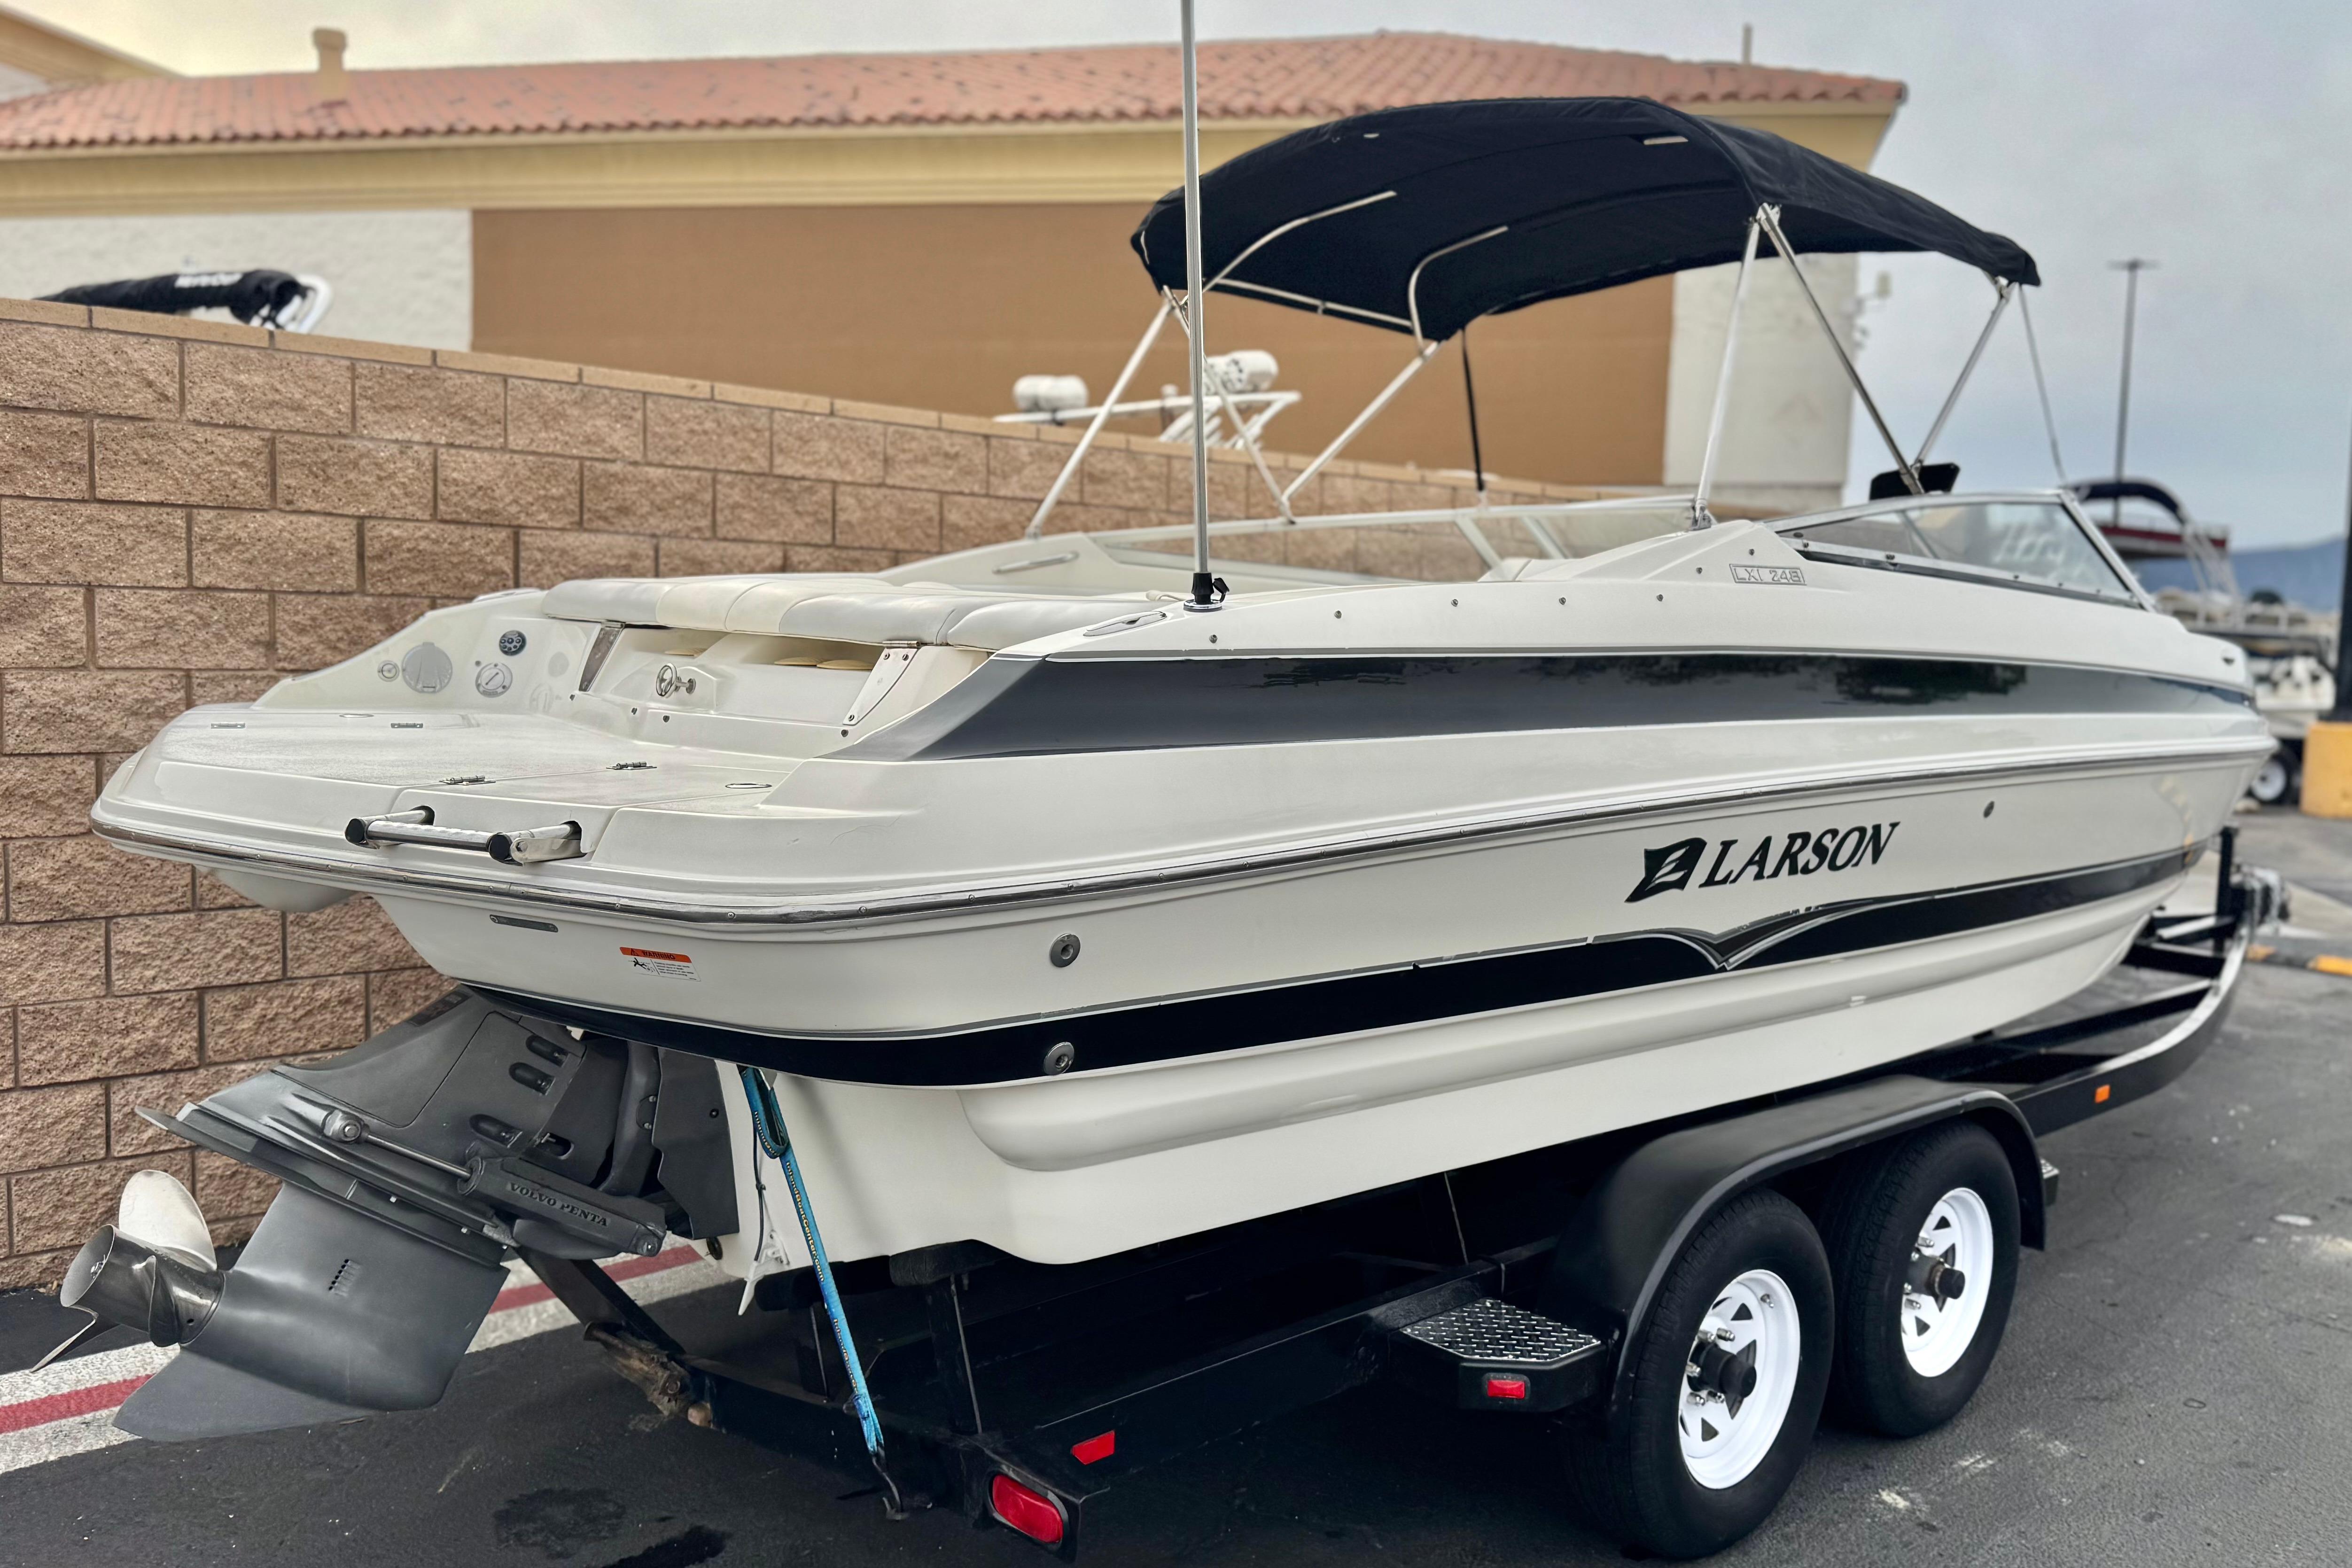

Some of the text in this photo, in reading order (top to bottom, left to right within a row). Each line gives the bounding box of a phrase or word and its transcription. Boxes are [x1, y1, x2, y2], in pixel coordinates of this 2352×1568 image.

[1698, 821, 1900, 888] LARSON
[642, 951, 676, 960] WARNING
[509, 1182, 608, 1227] VOLVO PENTA
